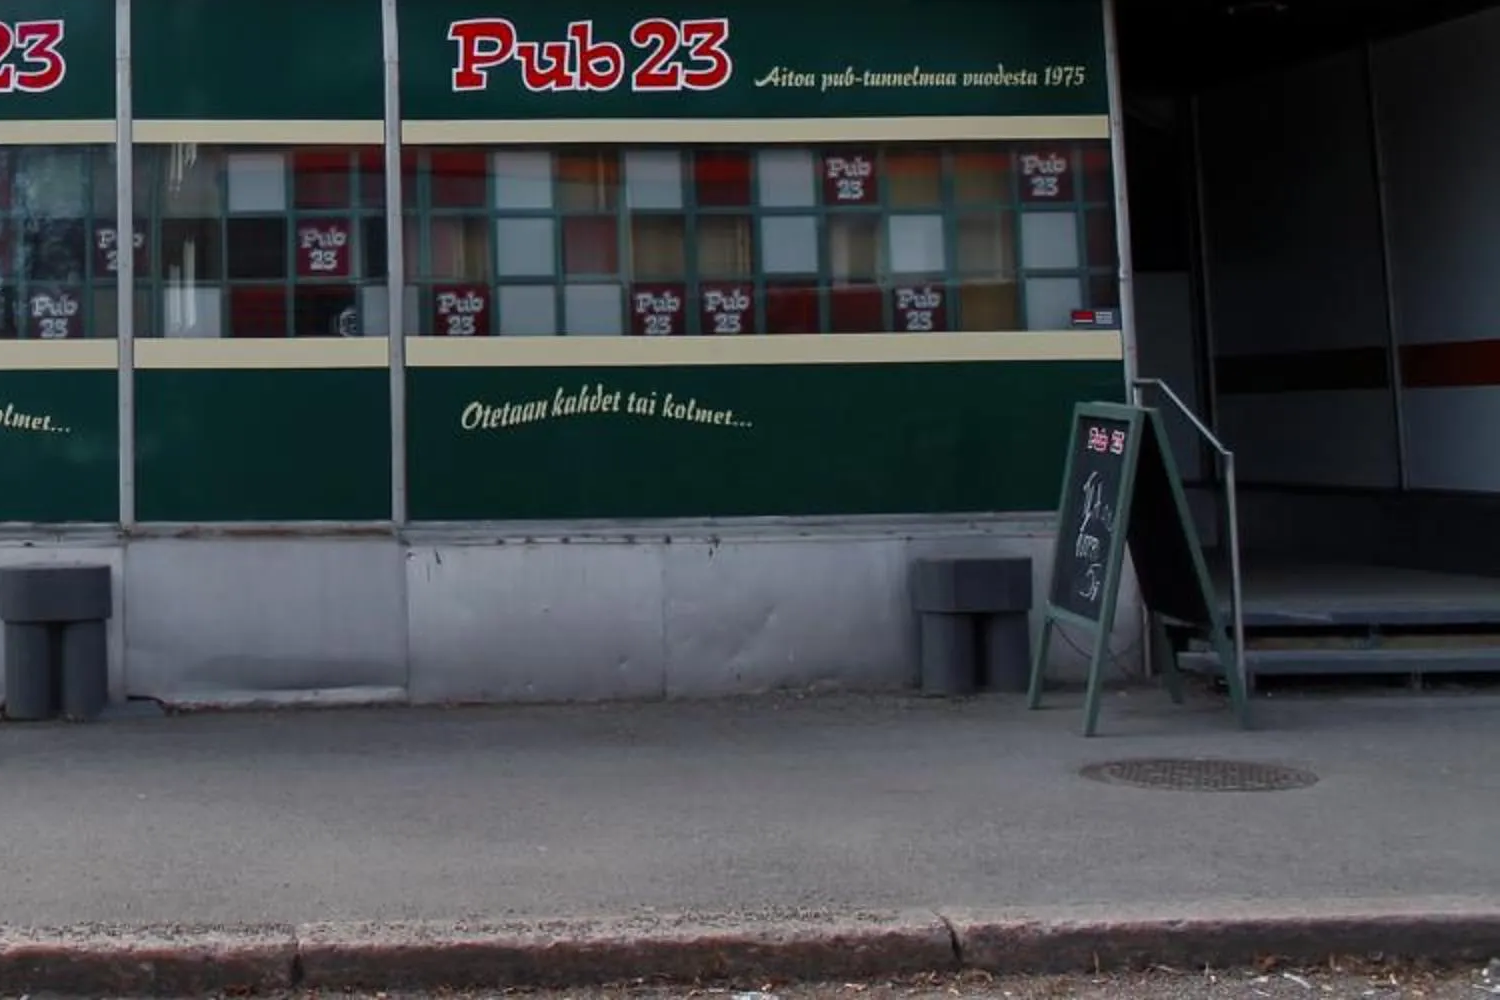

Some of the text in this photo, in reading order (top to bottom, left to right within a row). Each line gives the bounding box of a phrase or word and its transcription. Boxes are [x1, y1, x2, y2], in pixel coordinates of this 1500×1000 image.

[448, 16, 733, 92] Pub 23
[754, 64, 1086, 92] Aitoa pub-tunnelmaa vuodesta 1975
[826, 156, 872, 178] Pub
[1020, 153, 1067, 175] Pub
[836, 179, 864, 200] 23
[1030, 176, 1059, 196] 23
[298, 226, 347, 249] Pub
[308, 248, 338, 271] 23
[30, 292, 79, 317] Pub
[436, 291, 484, 313] Pub
[635, 291, 680, 313] Pub
[704, 289, 750, 312] Pub
[896, 286, 942, 309] Pub
[39, 317, 69, 339] 23
[446, 314, 476, 335] 23
[644, 314, 672, 335] 23
[714, 313, 741, 334] 23
[905, 310, 934, 331] 23
[461, 400, 548, 430] Otetaan
[551, 384, 621, 417] kahdet
[627, 392, 657, 416] tai
